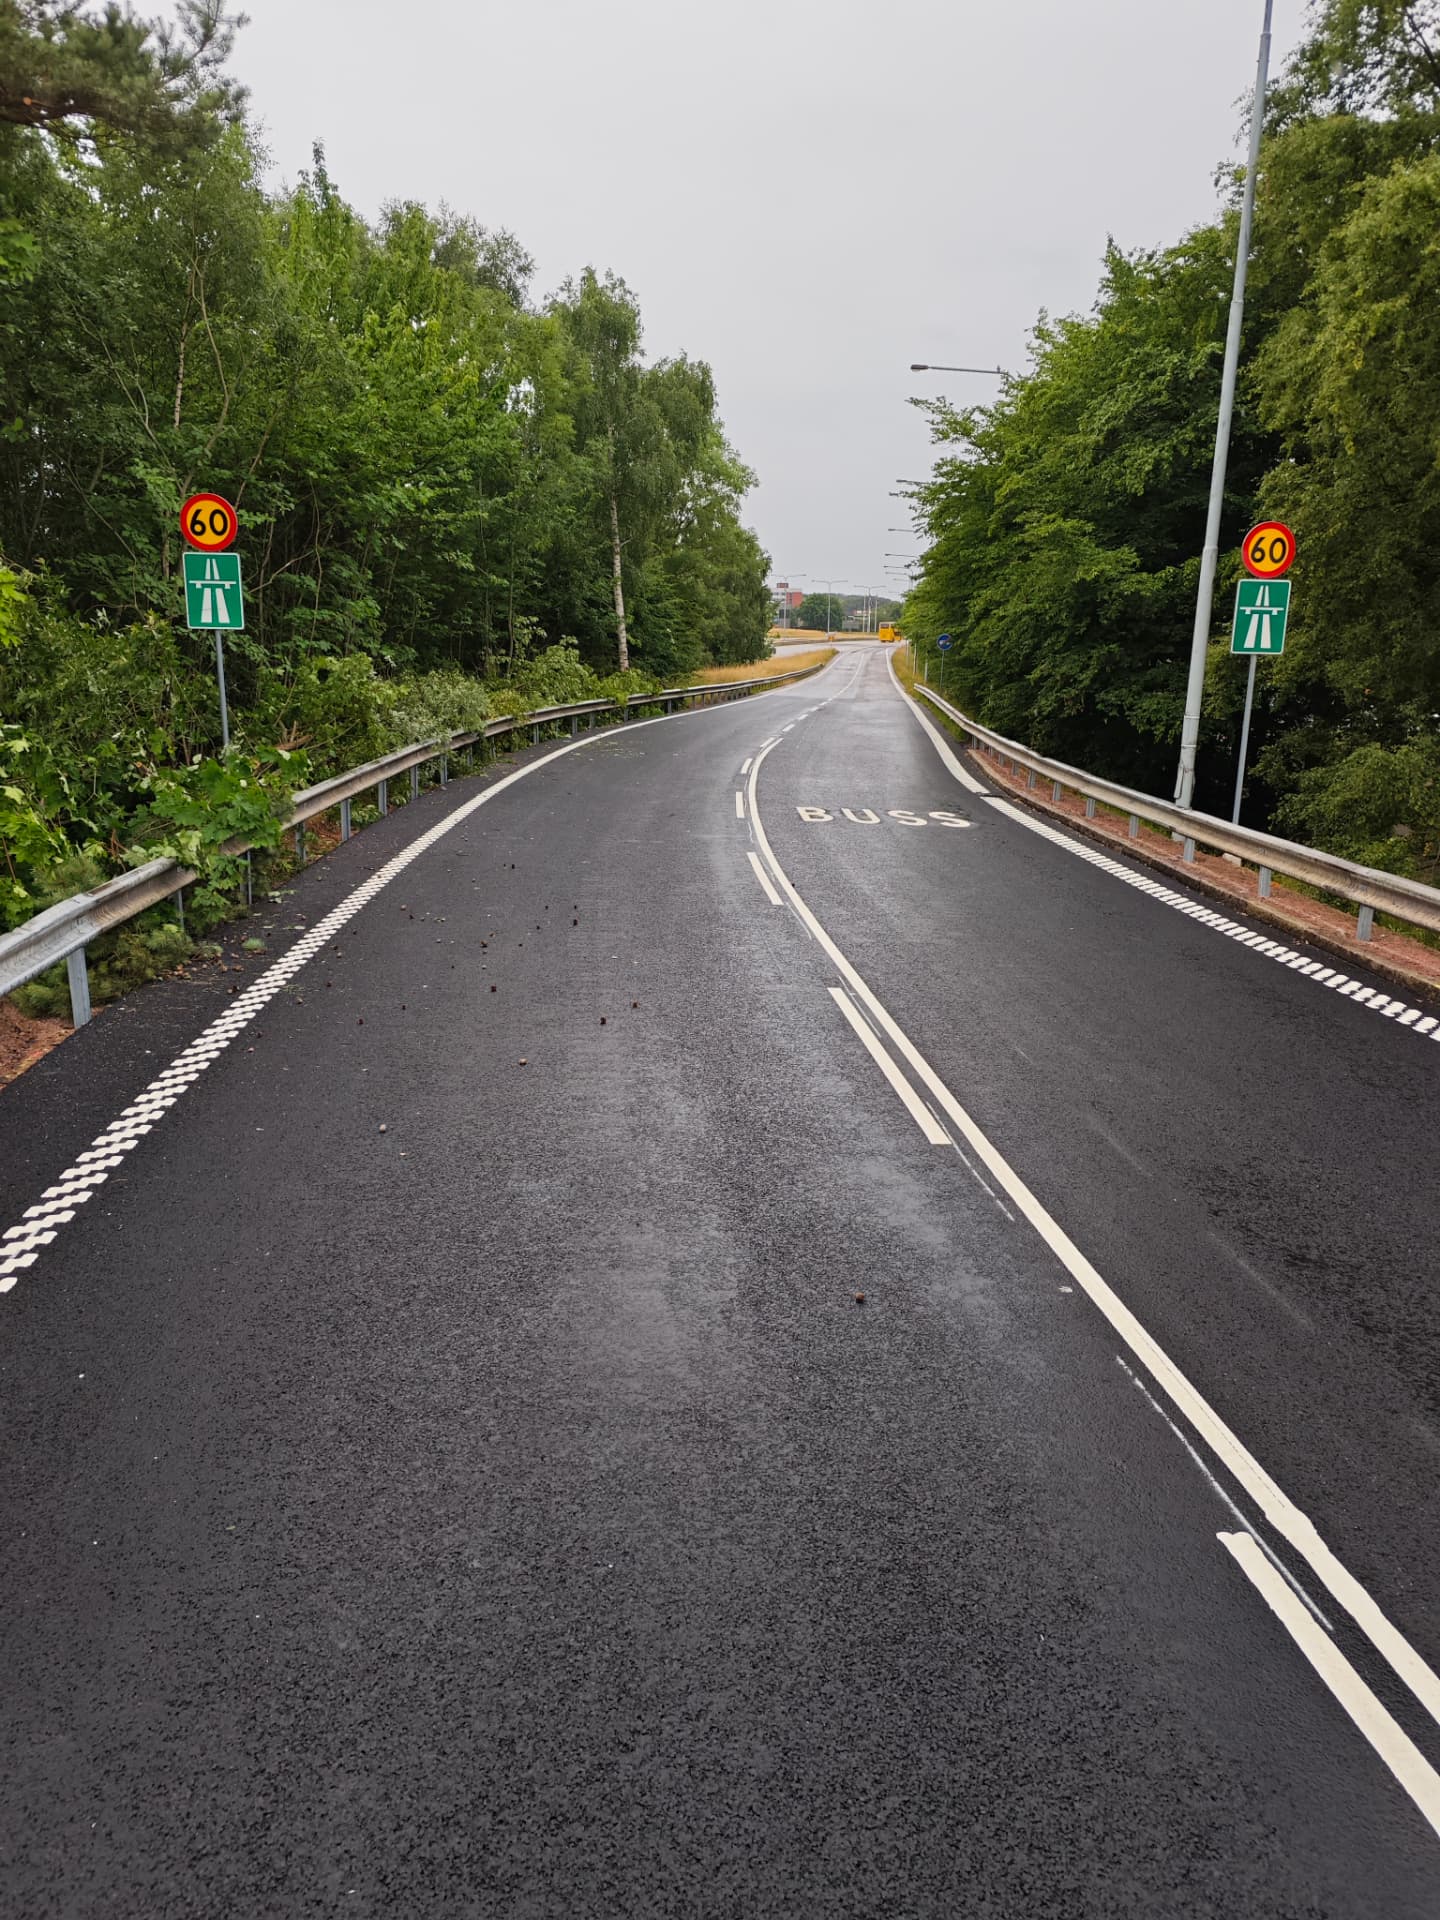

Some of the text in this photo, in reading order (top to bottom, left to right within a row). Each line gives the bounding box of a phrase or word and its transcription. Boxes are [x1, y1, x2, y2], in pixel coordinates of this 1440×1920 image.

[190, 509, 228, 536] 60
[1251, 537, 1287, 563] 60
[796, 806, 970, 827] BUSS
